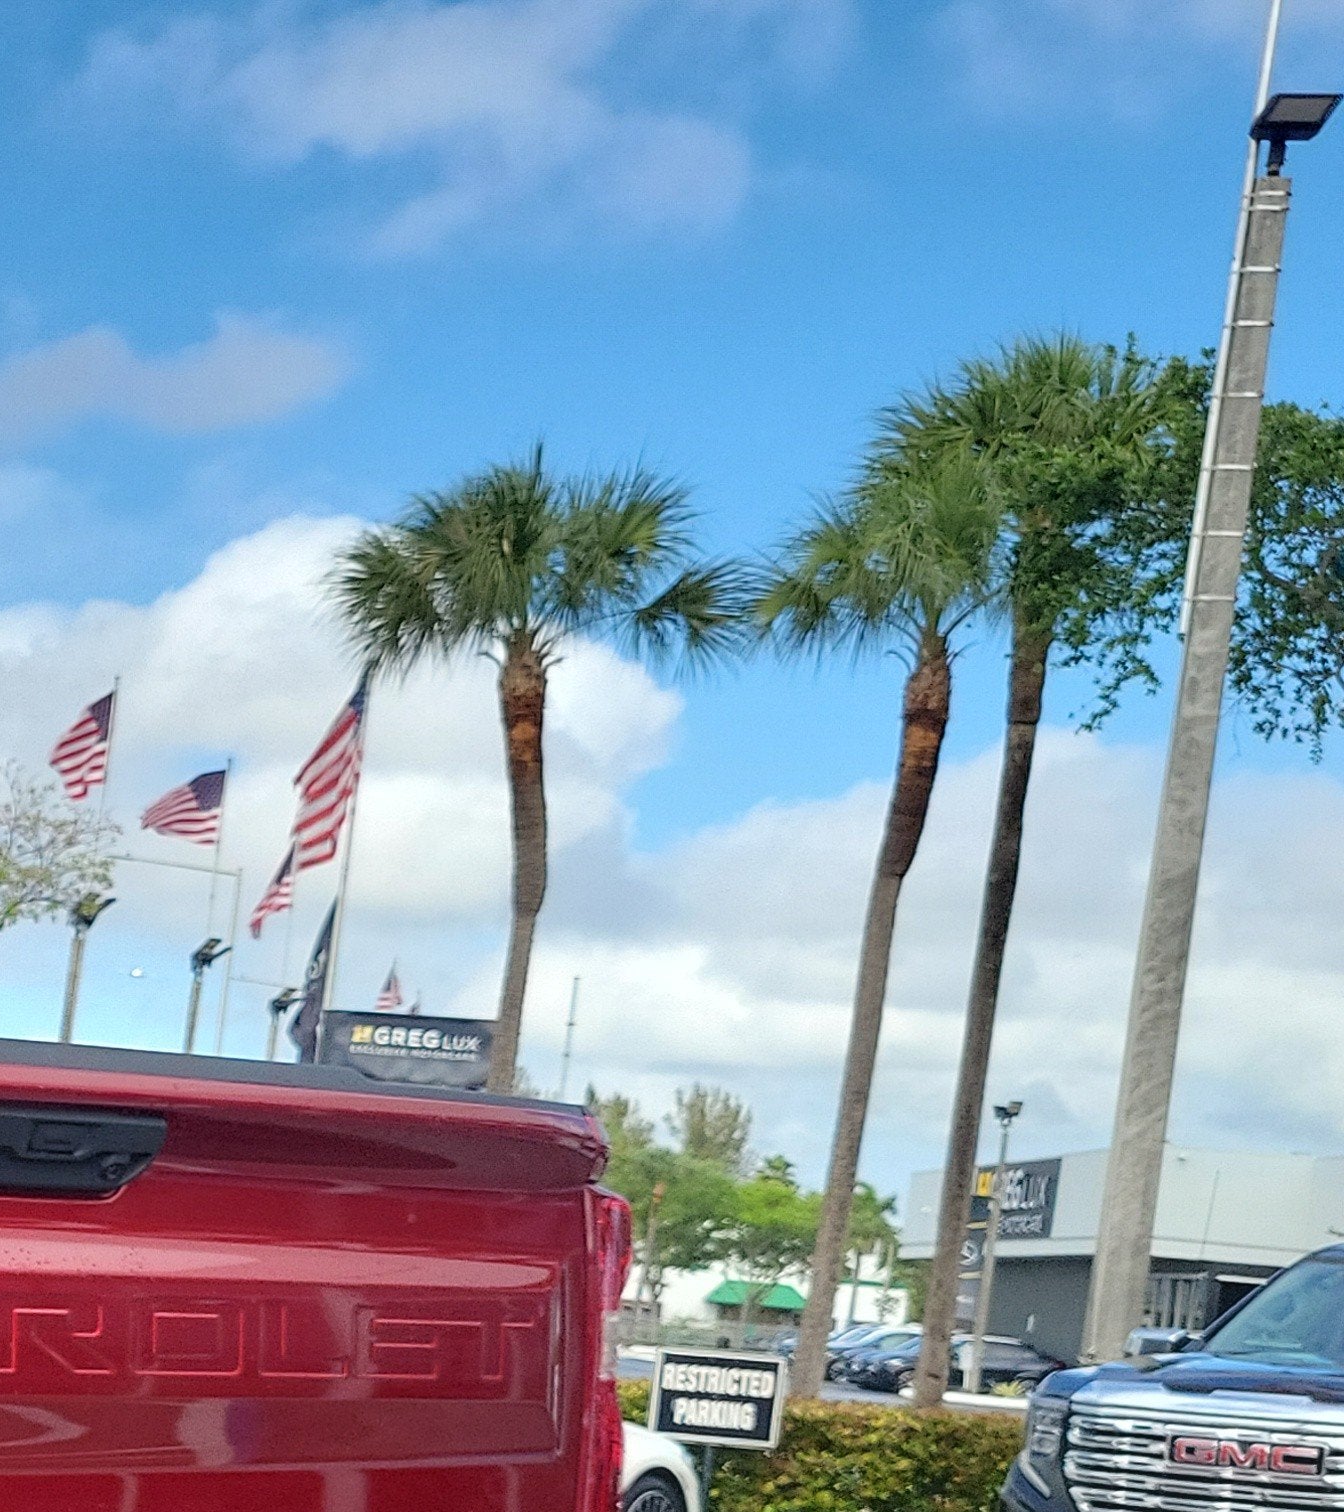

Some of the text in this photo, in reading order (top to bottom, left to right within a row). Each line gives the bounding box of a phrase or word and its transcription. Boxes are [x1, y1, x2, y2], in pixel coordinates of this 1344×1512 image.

[662, 1361, 776, 1399] RESTRICTED
[673, 1398, 758, 1431] PARKING
[1172, 1437, 1320, 1475] GMC
